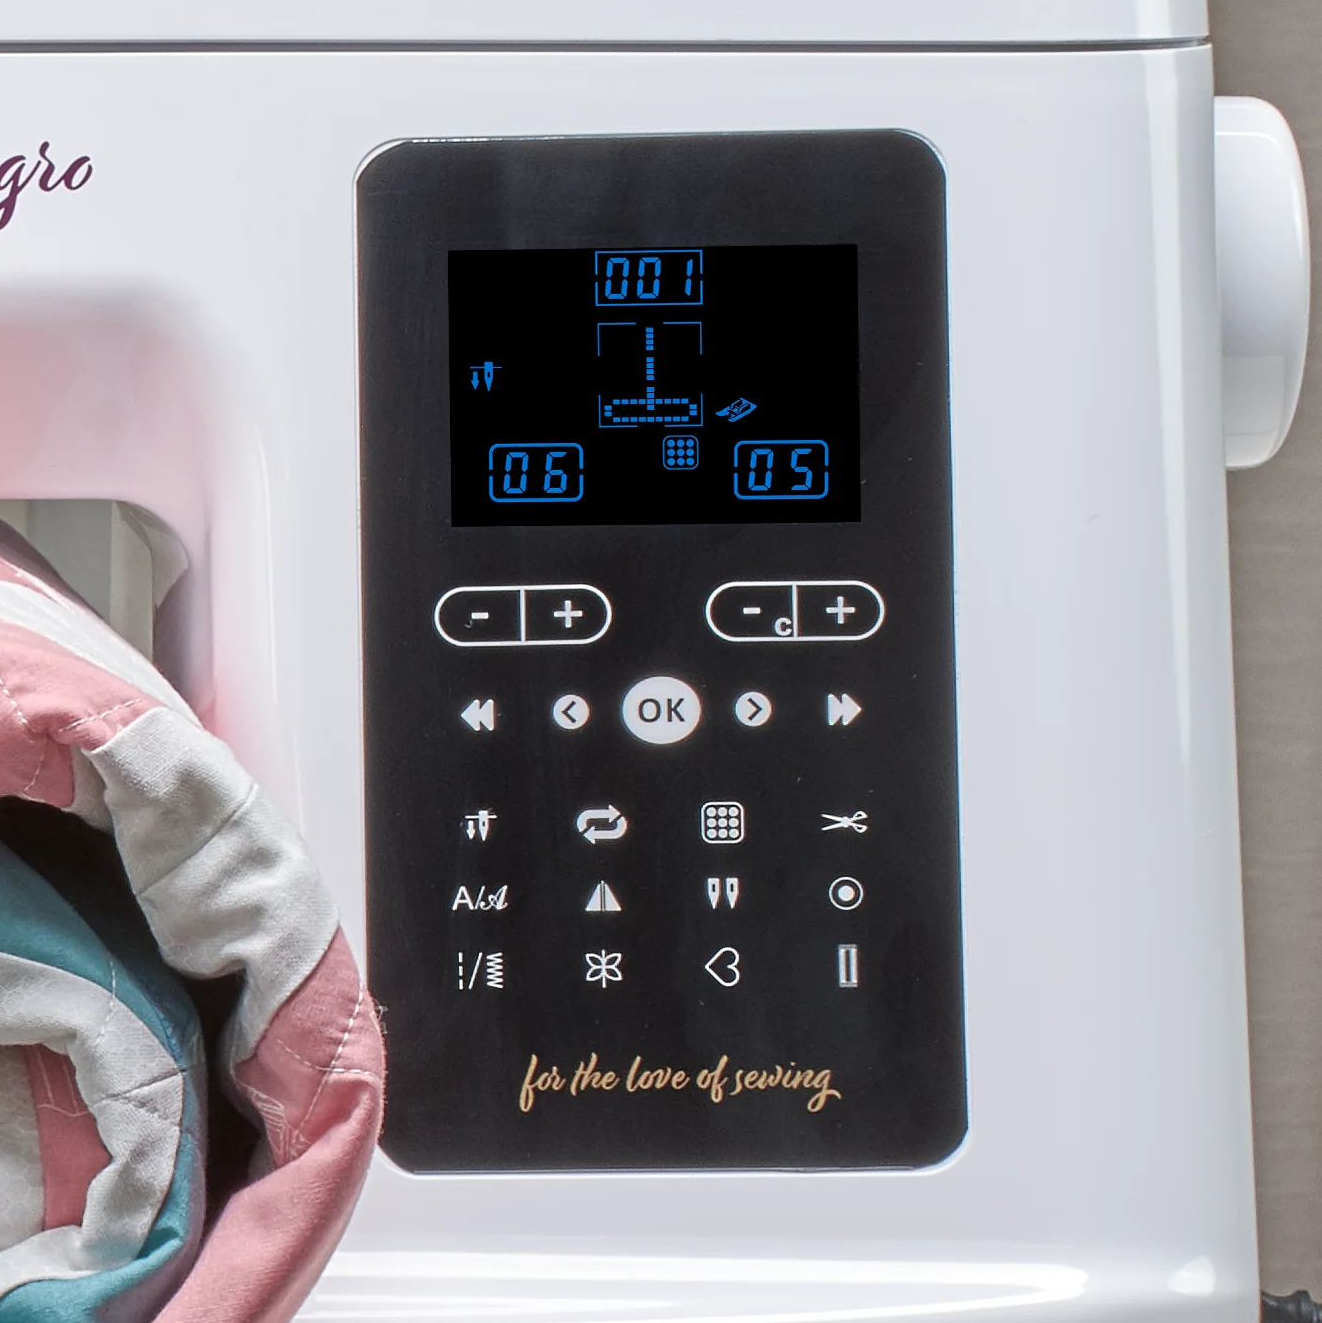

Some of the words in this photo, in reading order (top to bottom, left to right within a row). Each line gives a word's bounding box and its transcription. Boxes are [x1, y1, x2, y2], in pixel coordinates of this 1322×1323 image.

[604, 256, 695, 301] 001
[502, 450, 569, 495] 06
[747, 447, 814, 492] 05
[637, 697, 686, 724] OK
[519, 1053, 567, 1113] for
[570, 1052, 620, 1097] the
[625, 1055, 692, 1093] love
[696, 1054, 729, 1104] of
[729, 1062, 842, 1113] sewing
